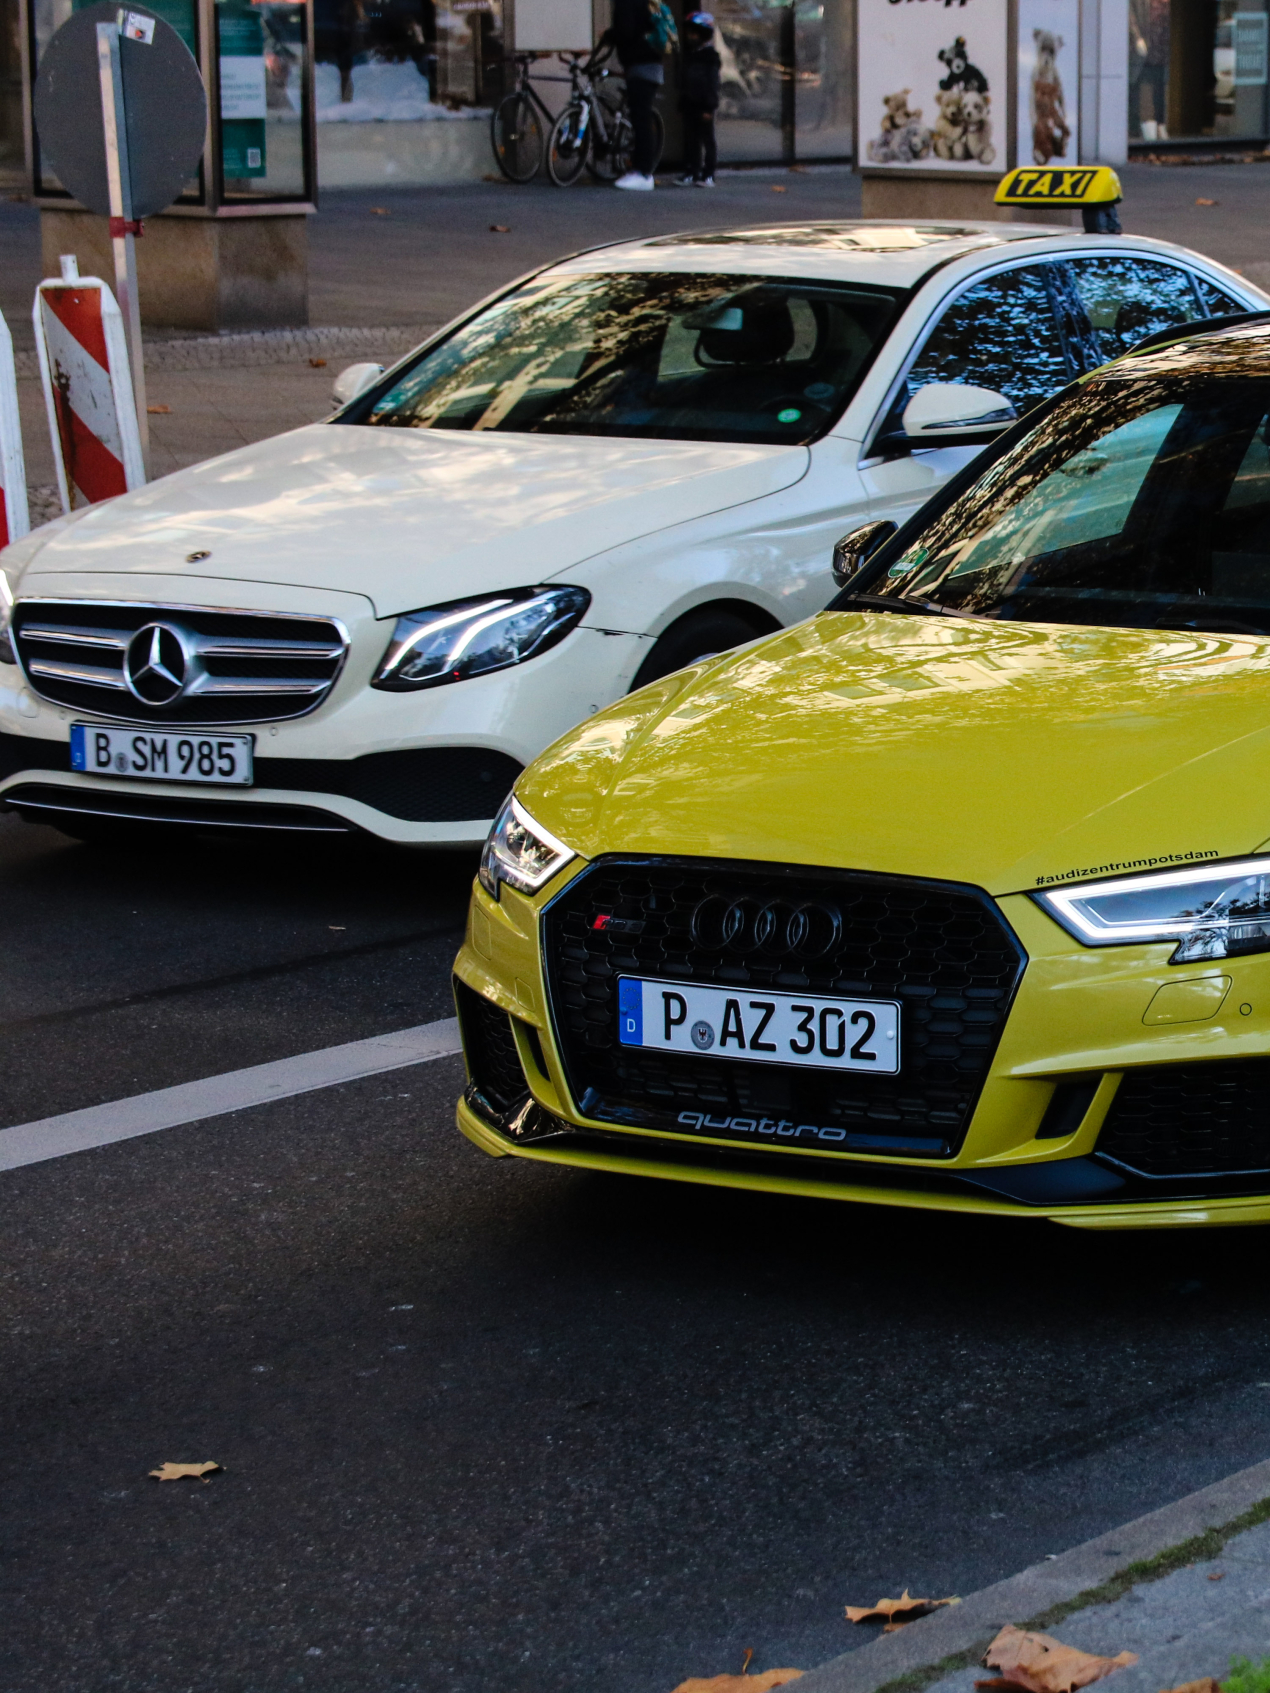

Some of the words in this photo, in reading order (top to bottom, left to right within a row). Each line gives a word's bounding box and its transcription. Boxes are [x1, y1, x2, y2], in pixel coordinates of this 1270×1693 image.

[1016, 172, 1093, 196] TAXI
[94, 732, 111, 768] B
[132, 736, 169, 773] SM
[178, 739, 236, 777] 985
[1035, 850, 1219, 885] #audizentrumpotsdam
[627, 1018, 636, 1033] D
[662, 990, 688, 1041] P
[719, 998, 778, 1052] AZ
[789, 1004, 877, 1061] 302
[677, 1111, 847, 1141] quattro
